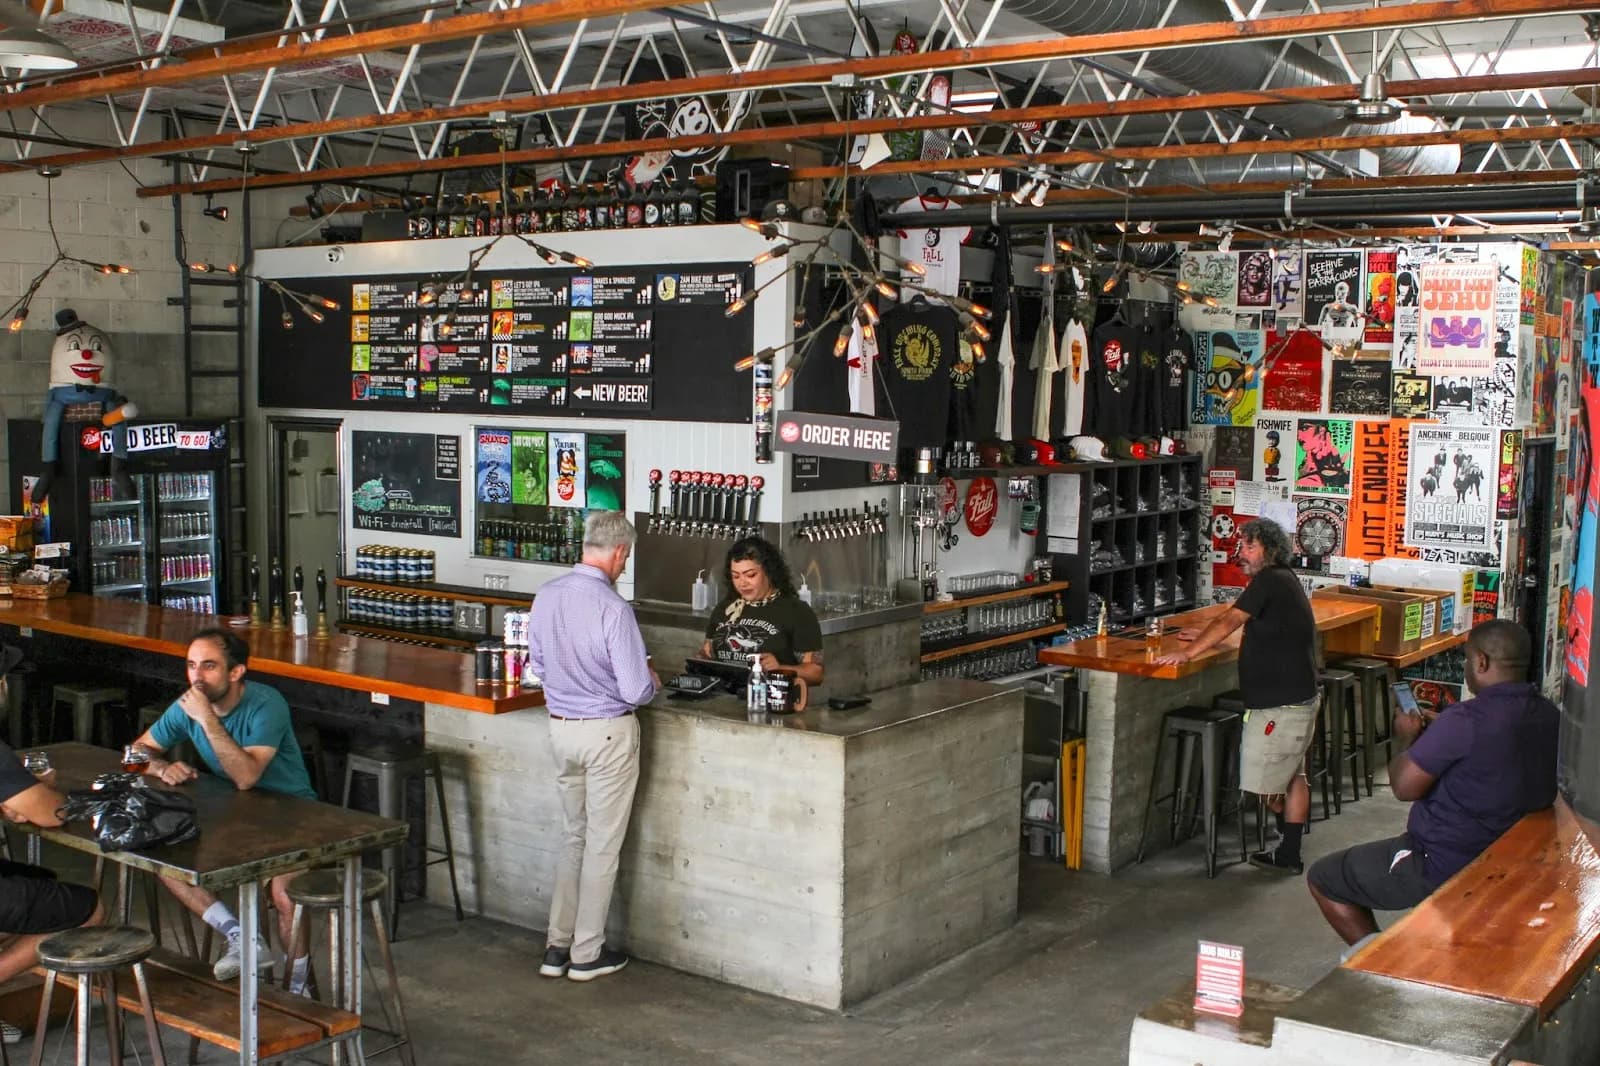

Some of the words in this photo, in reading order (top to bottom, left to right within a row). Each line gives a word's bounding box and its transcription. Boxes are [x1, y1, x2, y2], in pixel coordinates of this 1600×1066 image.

[1310, 257, 1345, 276] BEEHIVE
[1307, 266, 1360, 289] BARRACUDAS
[1423, 291, 1492, 311] JEHU
[592, 384, 616, 402] NEW
[617, 384, 649, 403] BEER!
[1256, 418, 1293, 432] FISHWIFE
[102, 429, 138, 452] CD
[144, 424, 177, 447] BEER
[179, 435, 190, 446] TO
[193, 435, 208, 446] GO!
[802, 423, 850, 447] ORDER
[853, 428, 893, 450] HERE
[1417, 430, 1453, 441] ANCIENNE
[1458, 431, 1491, 442] BELGIQUE
[969, 488, 995, 522] Fall
[1413, 500, 1488, 525] SPECIALS
[718, 650, 732, 660] SAN
